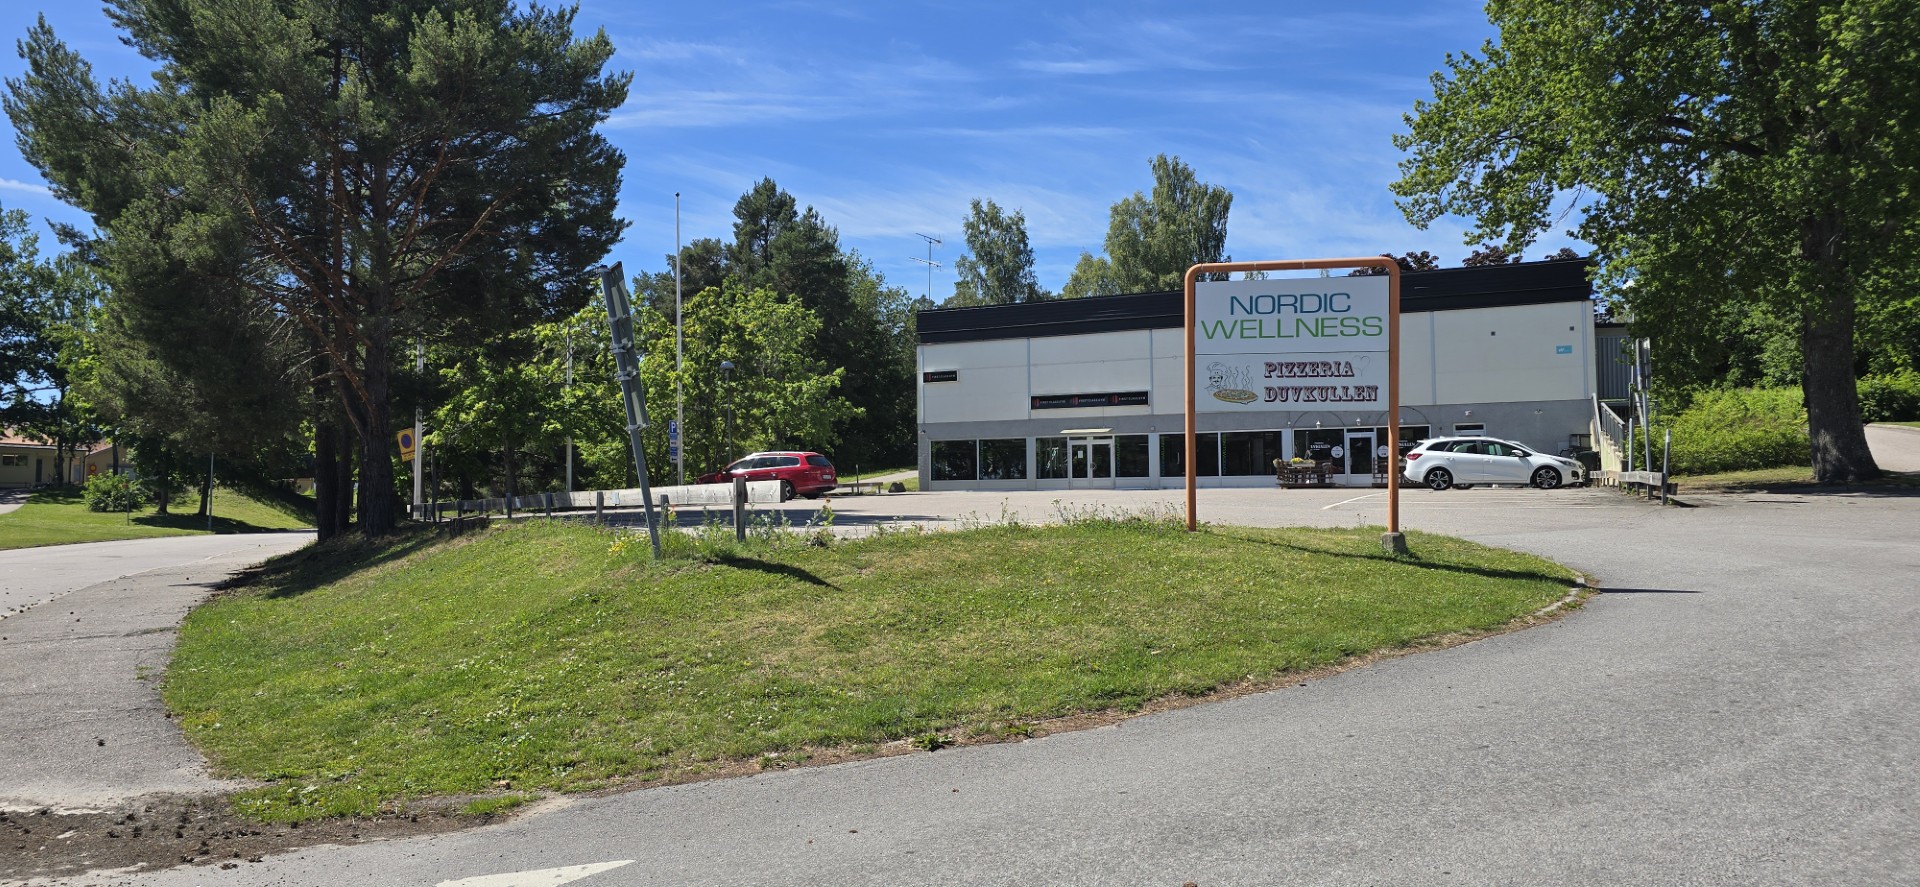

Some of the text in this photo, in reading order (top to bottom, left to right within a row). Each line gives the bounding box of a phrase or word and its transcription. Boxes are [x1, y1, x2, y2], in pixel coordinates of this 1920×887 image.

[1230, 292, 1351, 315] NORDIC
[1201, 316, 1383, 340] WELLNESS
[1264, 360, 1355, 379] PIZZERIA
[1264, 385, 1379, 403] DUVKULLEN
[671, 421, 676, 432] P
